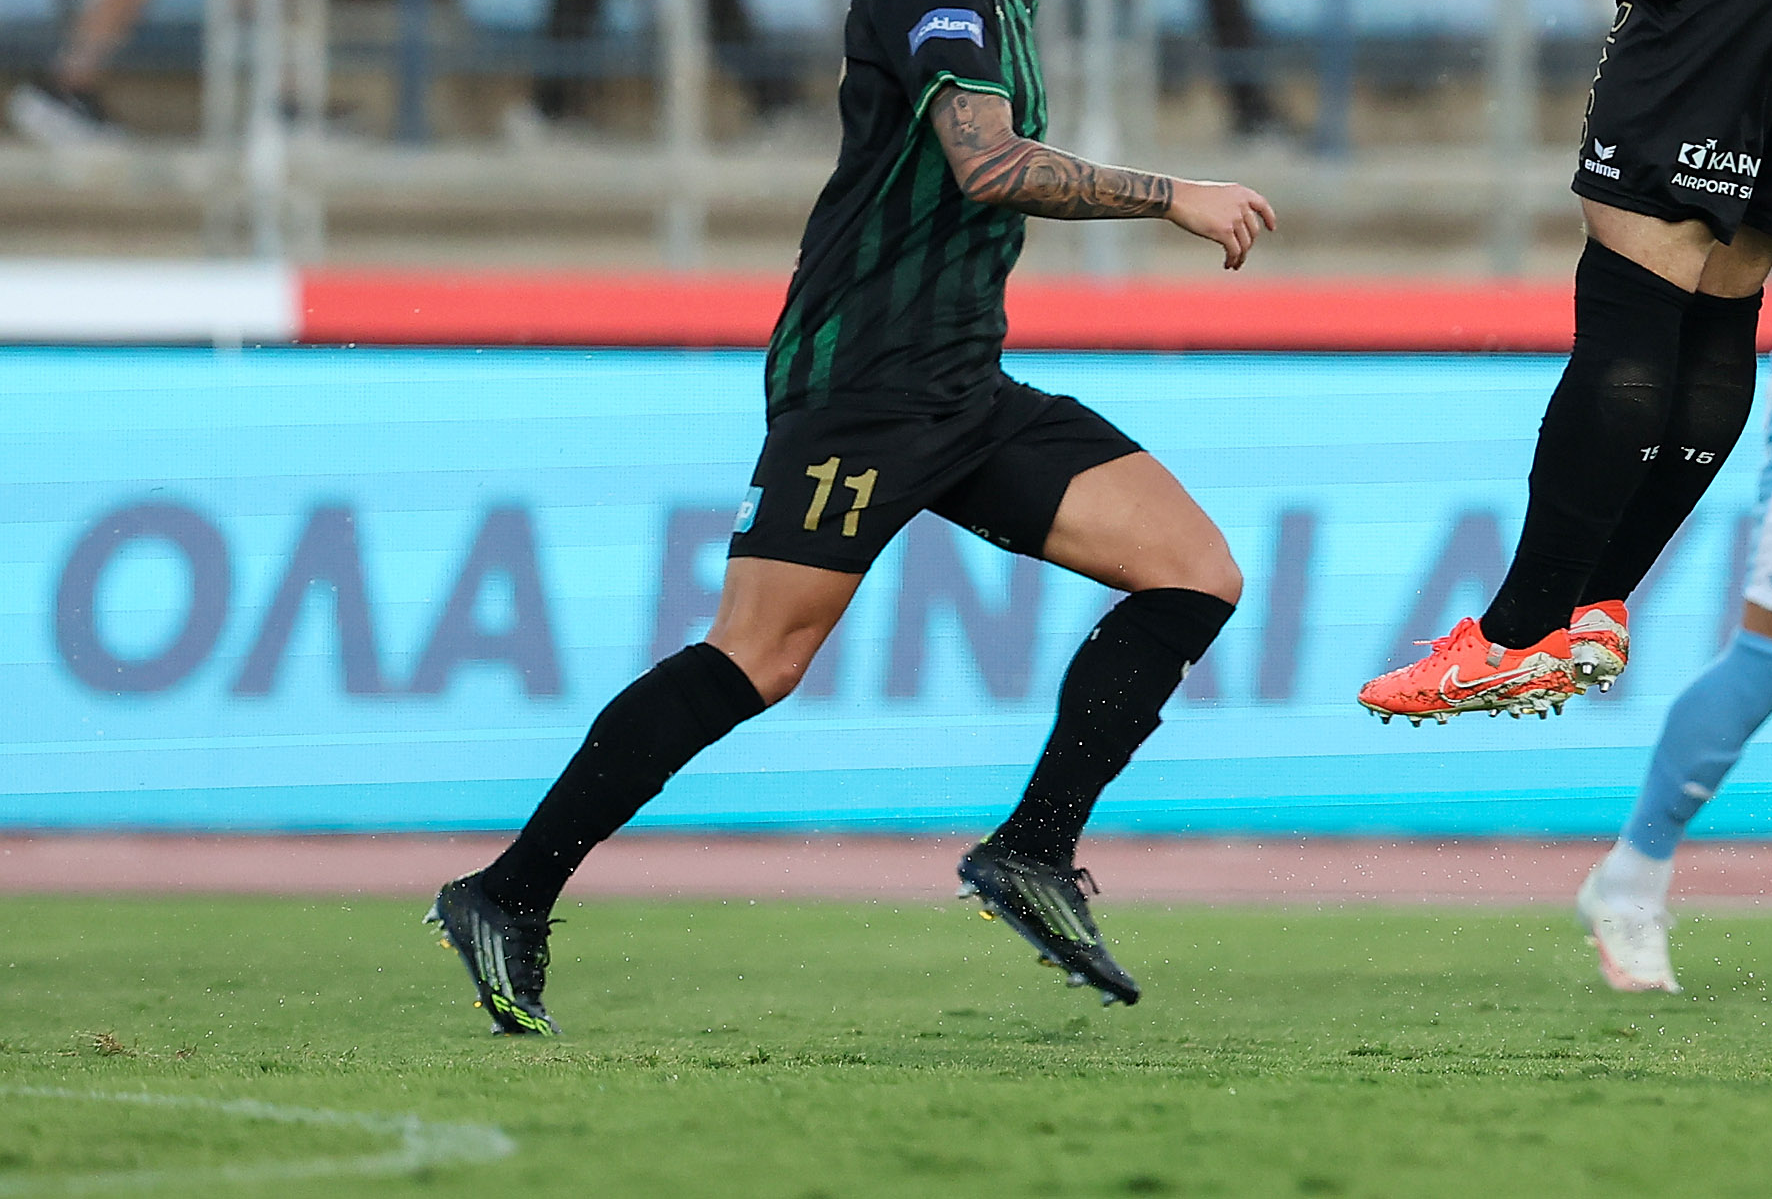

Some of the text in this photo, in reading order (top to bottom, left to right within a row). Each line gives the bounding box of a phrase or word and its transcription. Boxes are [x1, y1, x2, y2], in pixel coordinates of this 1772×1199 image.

[1584, 158, 1621, 180] erima
[1671, 172, 1738, 197] AIRPORT
[1680, 446, 1716, 464] 15
[803, 456, 879, 538] 11
